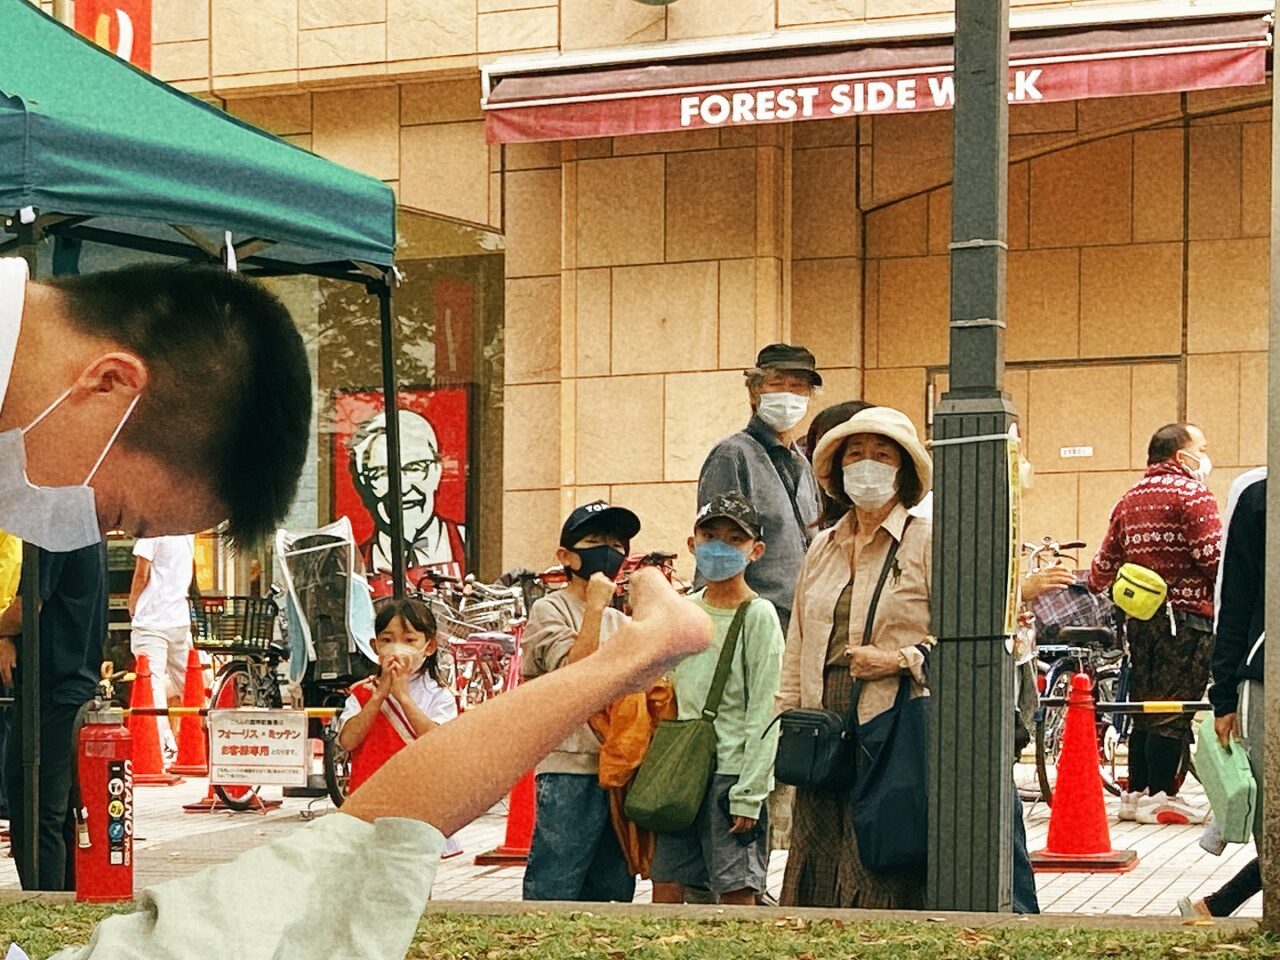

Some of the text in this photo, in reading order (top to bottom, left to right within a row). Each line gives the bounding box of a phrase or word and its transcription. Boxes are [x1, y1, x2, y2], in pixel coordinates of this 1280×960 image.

[679, 68, 1044, 127] FOREST SIDE WK
